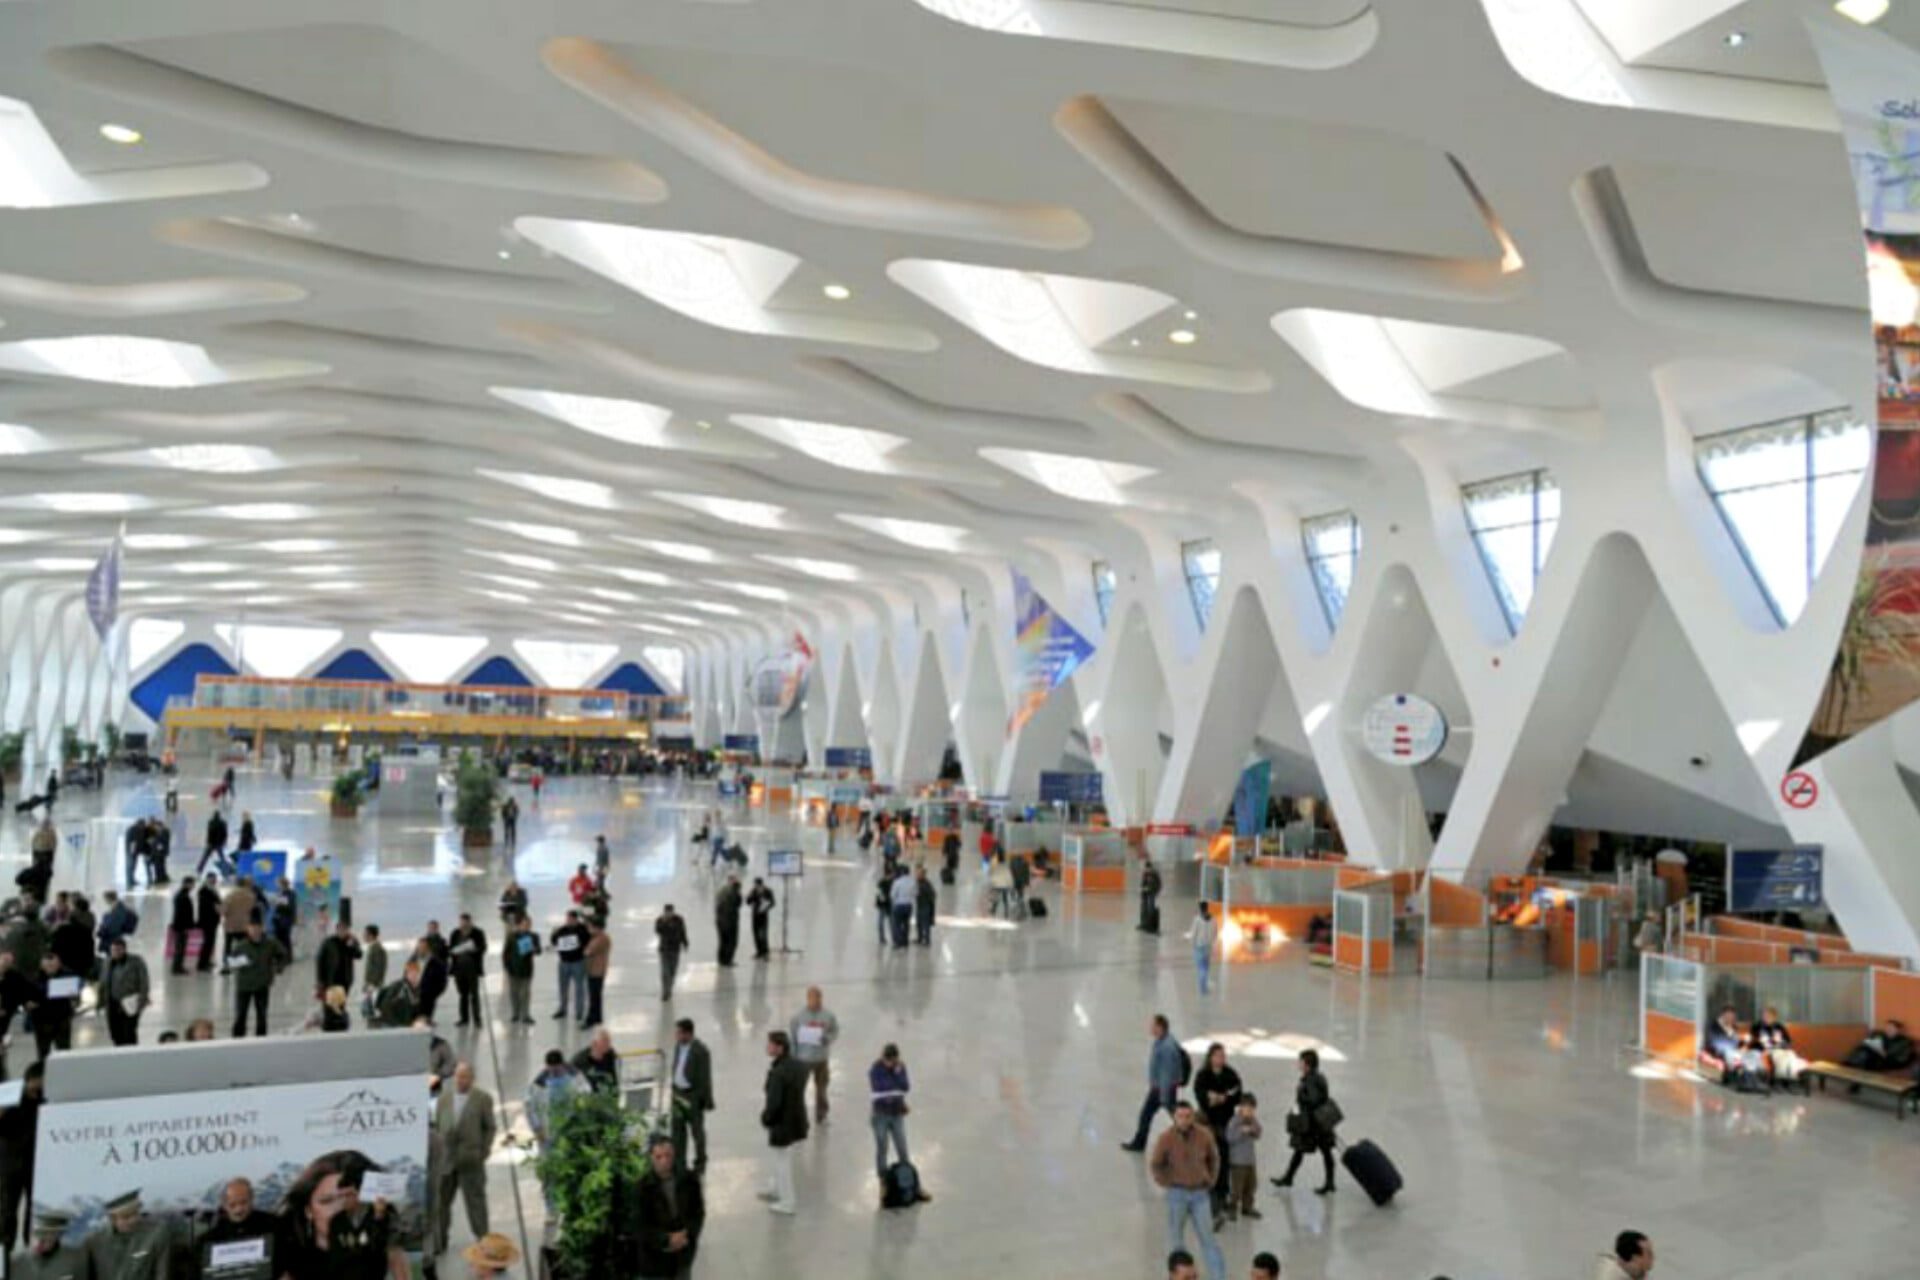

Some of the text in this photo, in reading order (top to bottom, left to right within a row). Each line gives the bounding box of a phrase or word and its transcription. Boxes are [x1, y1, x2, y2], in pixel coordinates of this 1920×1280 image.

[48, 1110, 259, 1144] VOTRE APPARTEMENT
[347, 1106, 417, 1133] ATLAS
[132, 1130, 237, 1163] 100.000
